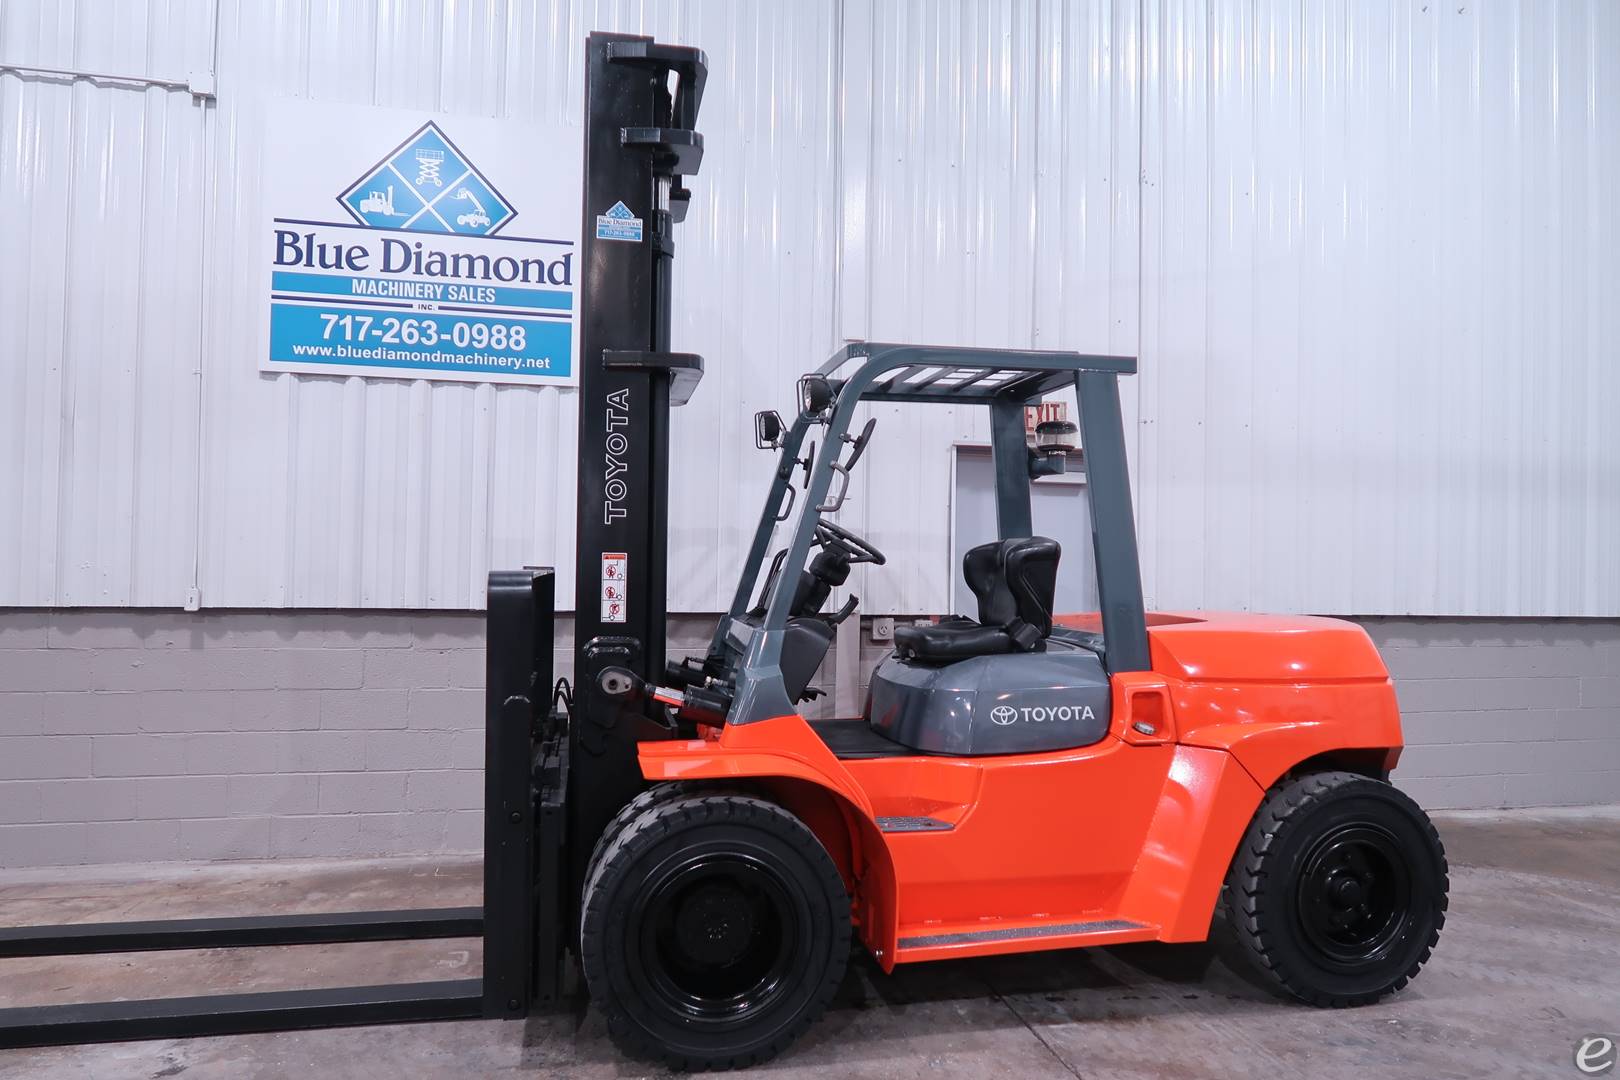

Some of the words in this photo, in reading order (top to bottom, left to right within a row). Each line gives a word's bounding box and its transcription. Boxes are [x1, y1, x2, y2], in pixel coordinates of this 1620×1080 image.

[273, 230, 369, 271] Blue
[380, 238, 573, 285] Diamond
[352, 279, 442, 300] MACHINERY
[447, 285, 496, 303] SALES
[418, 303, 435, 311] INC.
[320, 314, 526, 351] 717-263-0988
[293, 344, 551, 369] www.bluediamondmachinery.net
[1024, 403, 1060, 432] EXIT
[605, 388, 629, 525] TOYOTA
[1020, 706, 1095, 722] TOYOTA
